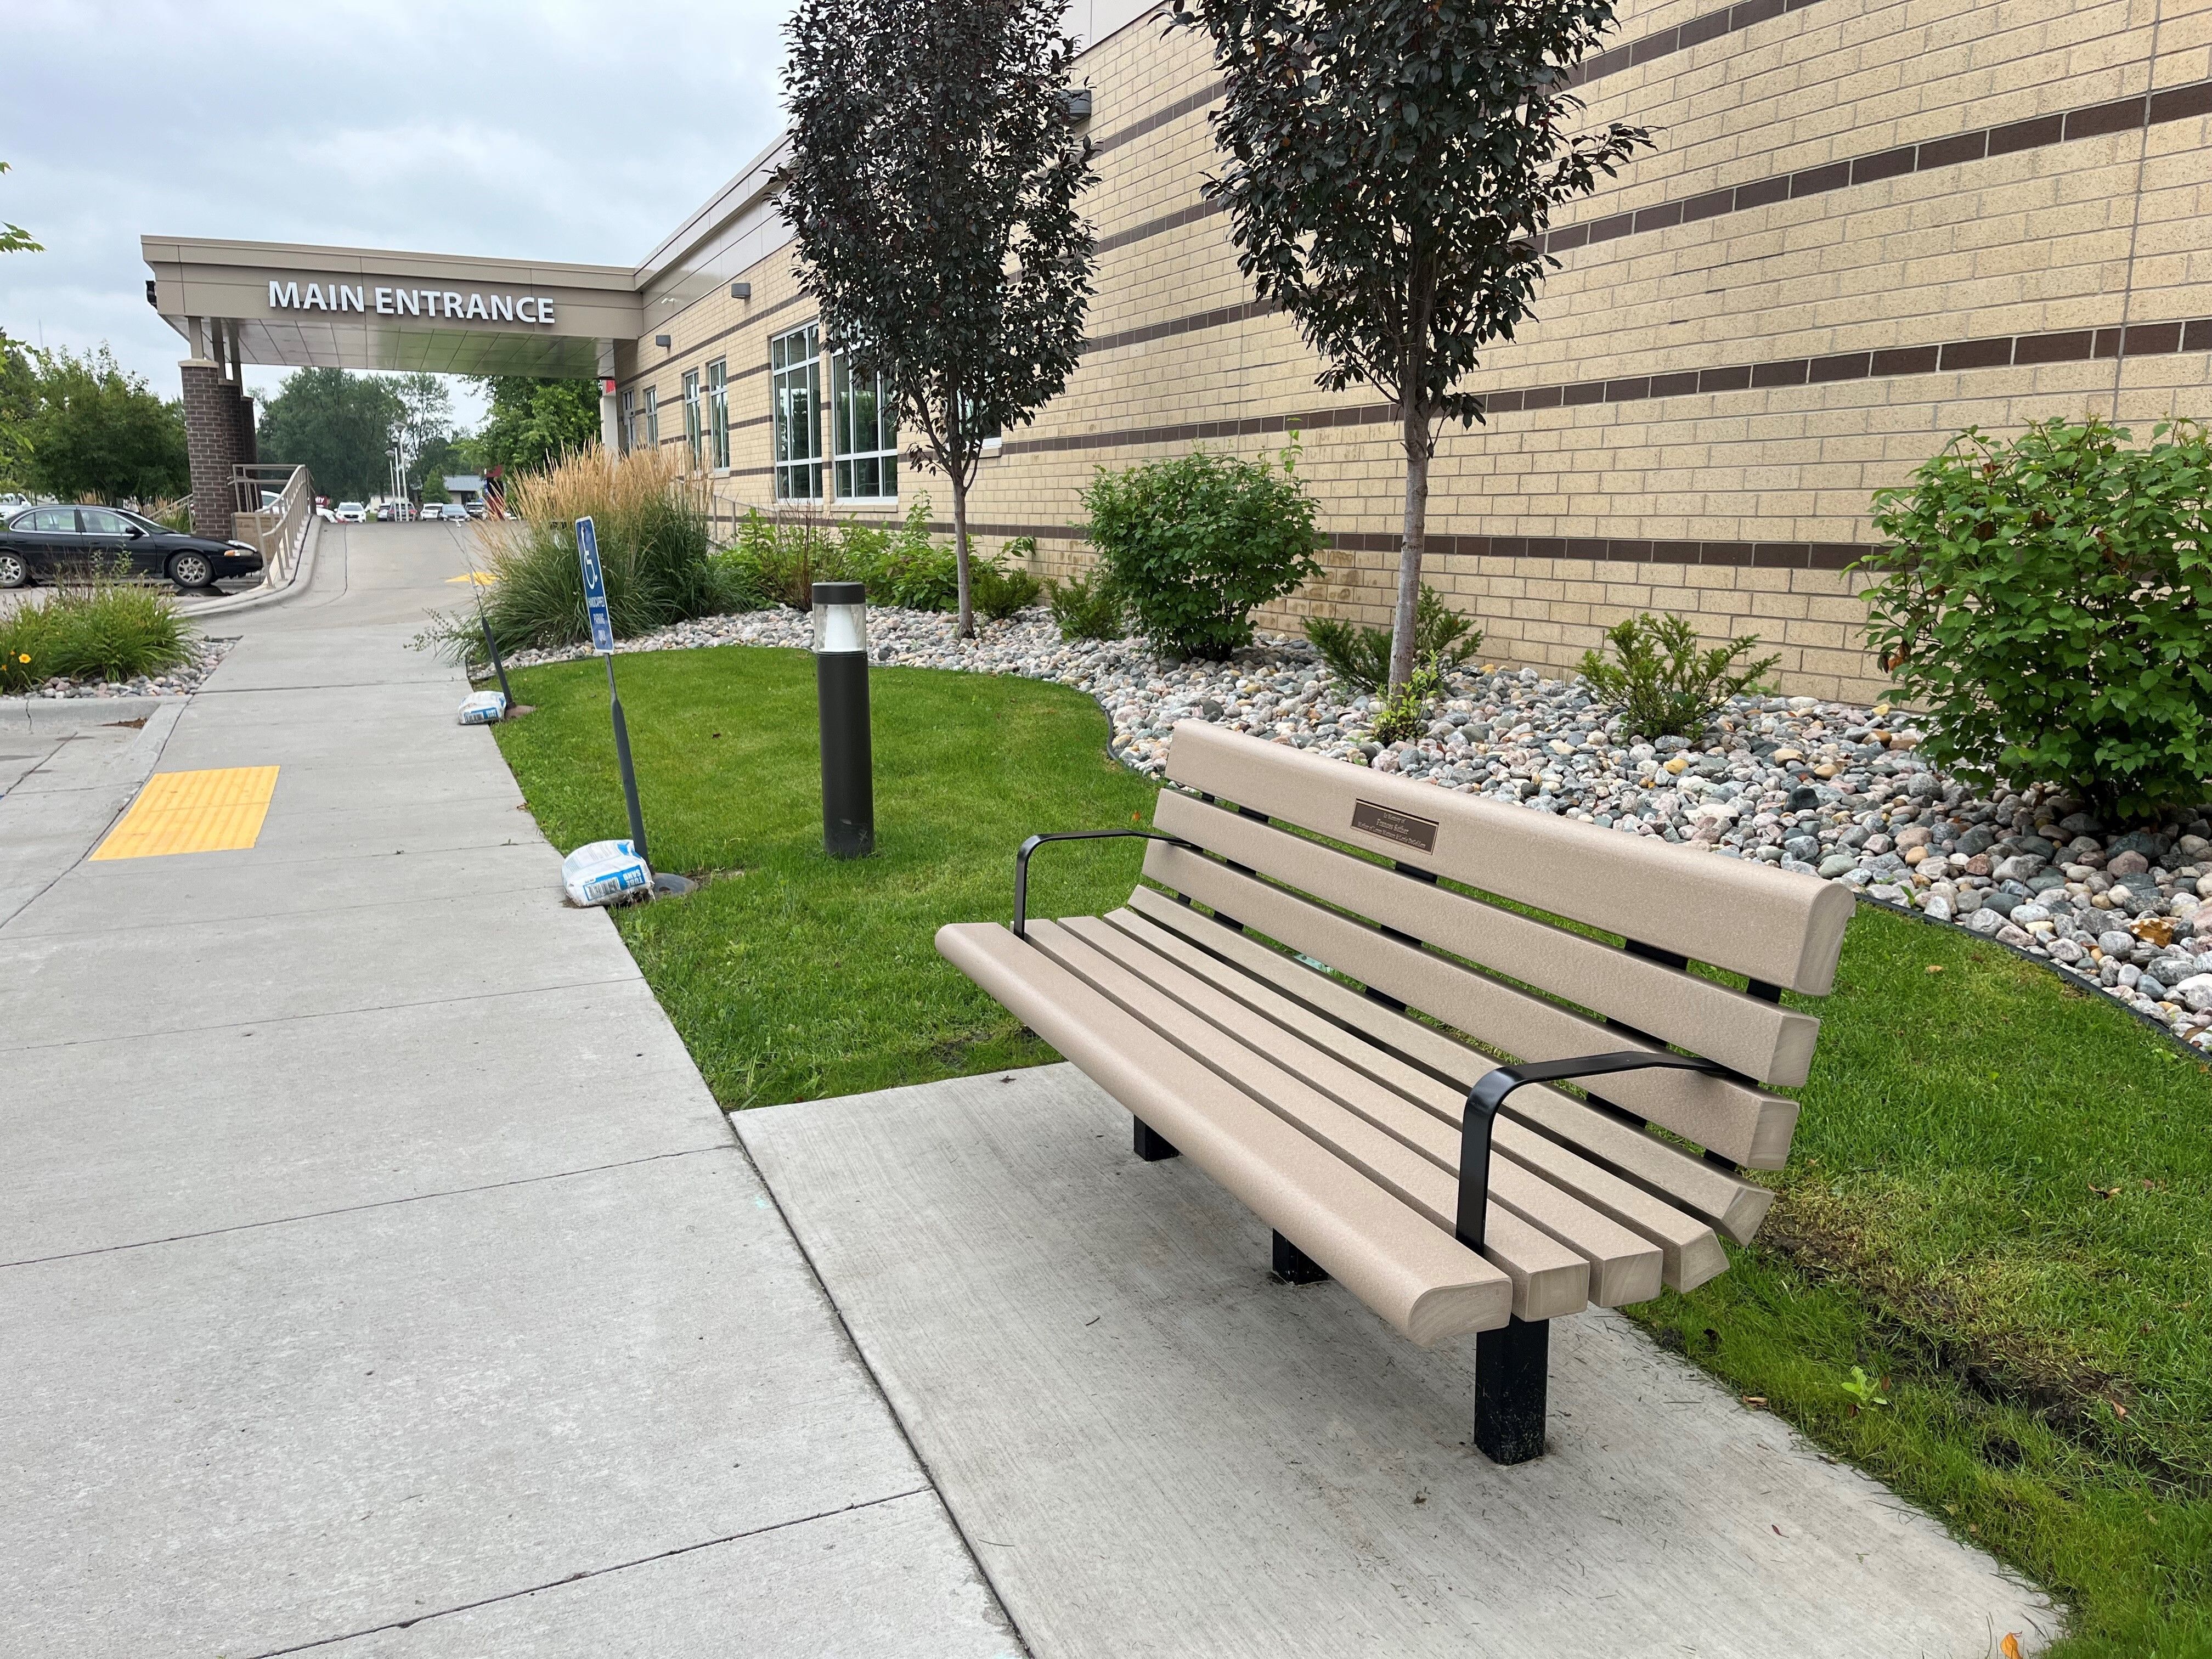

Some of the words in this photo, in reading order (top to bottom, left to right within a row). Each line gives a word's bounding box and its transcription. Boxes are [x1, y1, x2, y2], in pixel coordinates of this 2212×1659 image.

[269, 280, 364, 312] MAIN
[375, 287, 555, 323] ENTRANCE
[1376, 819, 1393, 830] Frances
[623, 869, 641, 881] SAND
